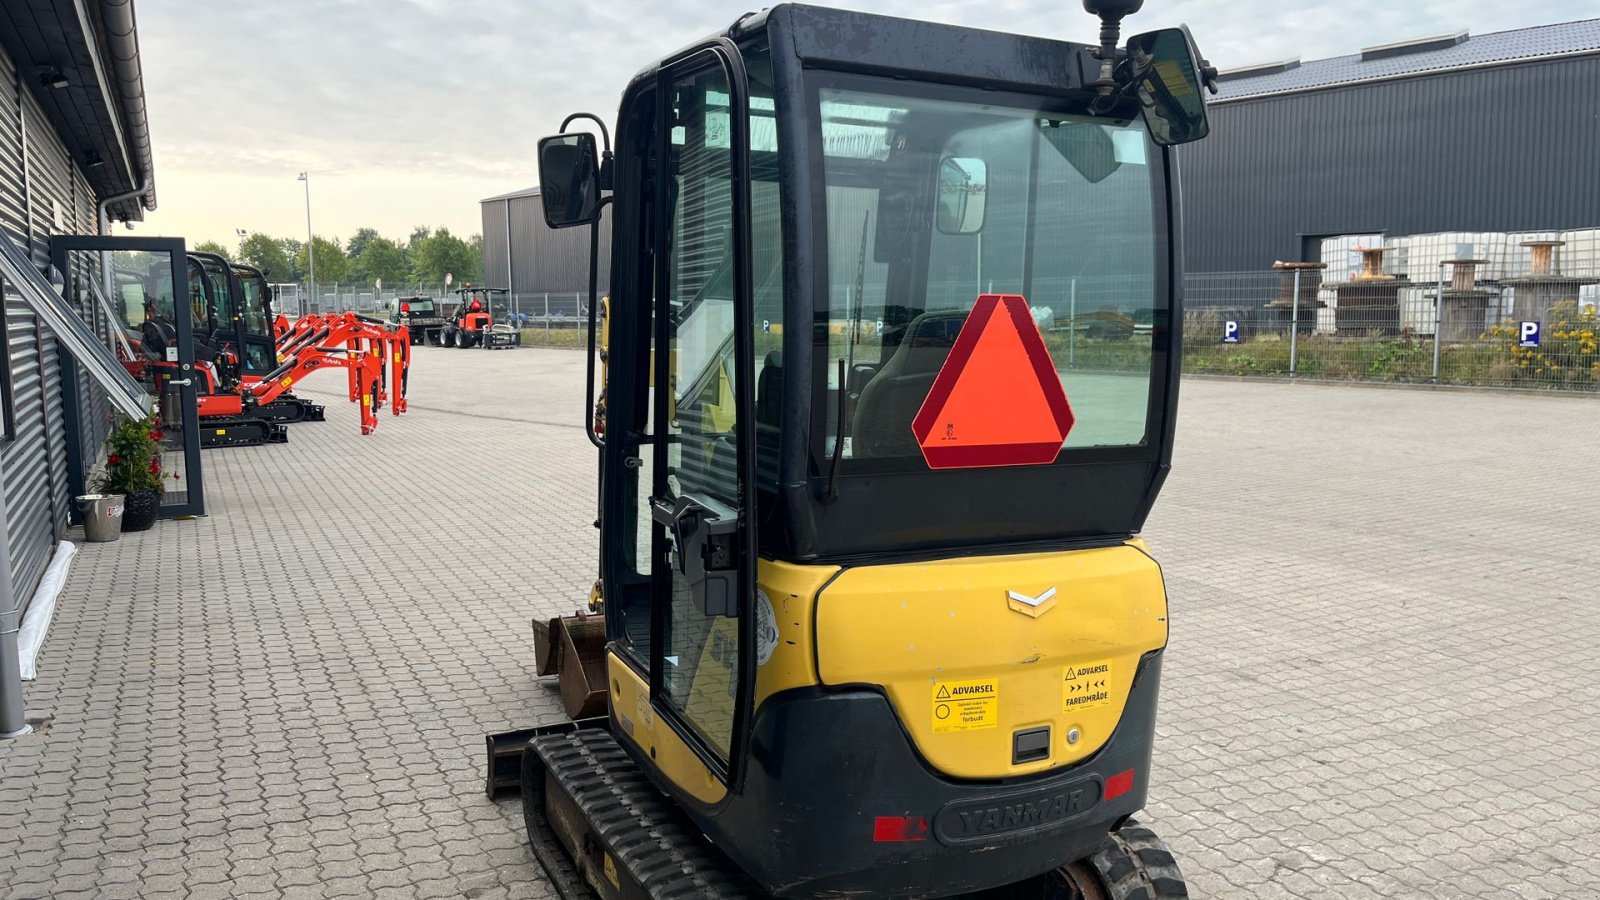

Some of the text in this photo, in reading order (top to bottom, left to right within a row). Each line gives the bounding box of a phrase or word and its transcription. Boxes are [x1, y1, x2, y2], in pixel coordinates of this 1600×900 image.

[764, 320, 769, 330] P
[876, 321, 883, 331] P
[1225, 321, 1237, 337] P
[1521, 321, 1538, 341] P
[1077, 664, 1109, 676] ADVARSEL
[952, 684, 995, 695] ADVARSEL
[1066, 691, 1109, 706] FAREOMRÅDE
[960, 789, 1084, 833] YANMAR
